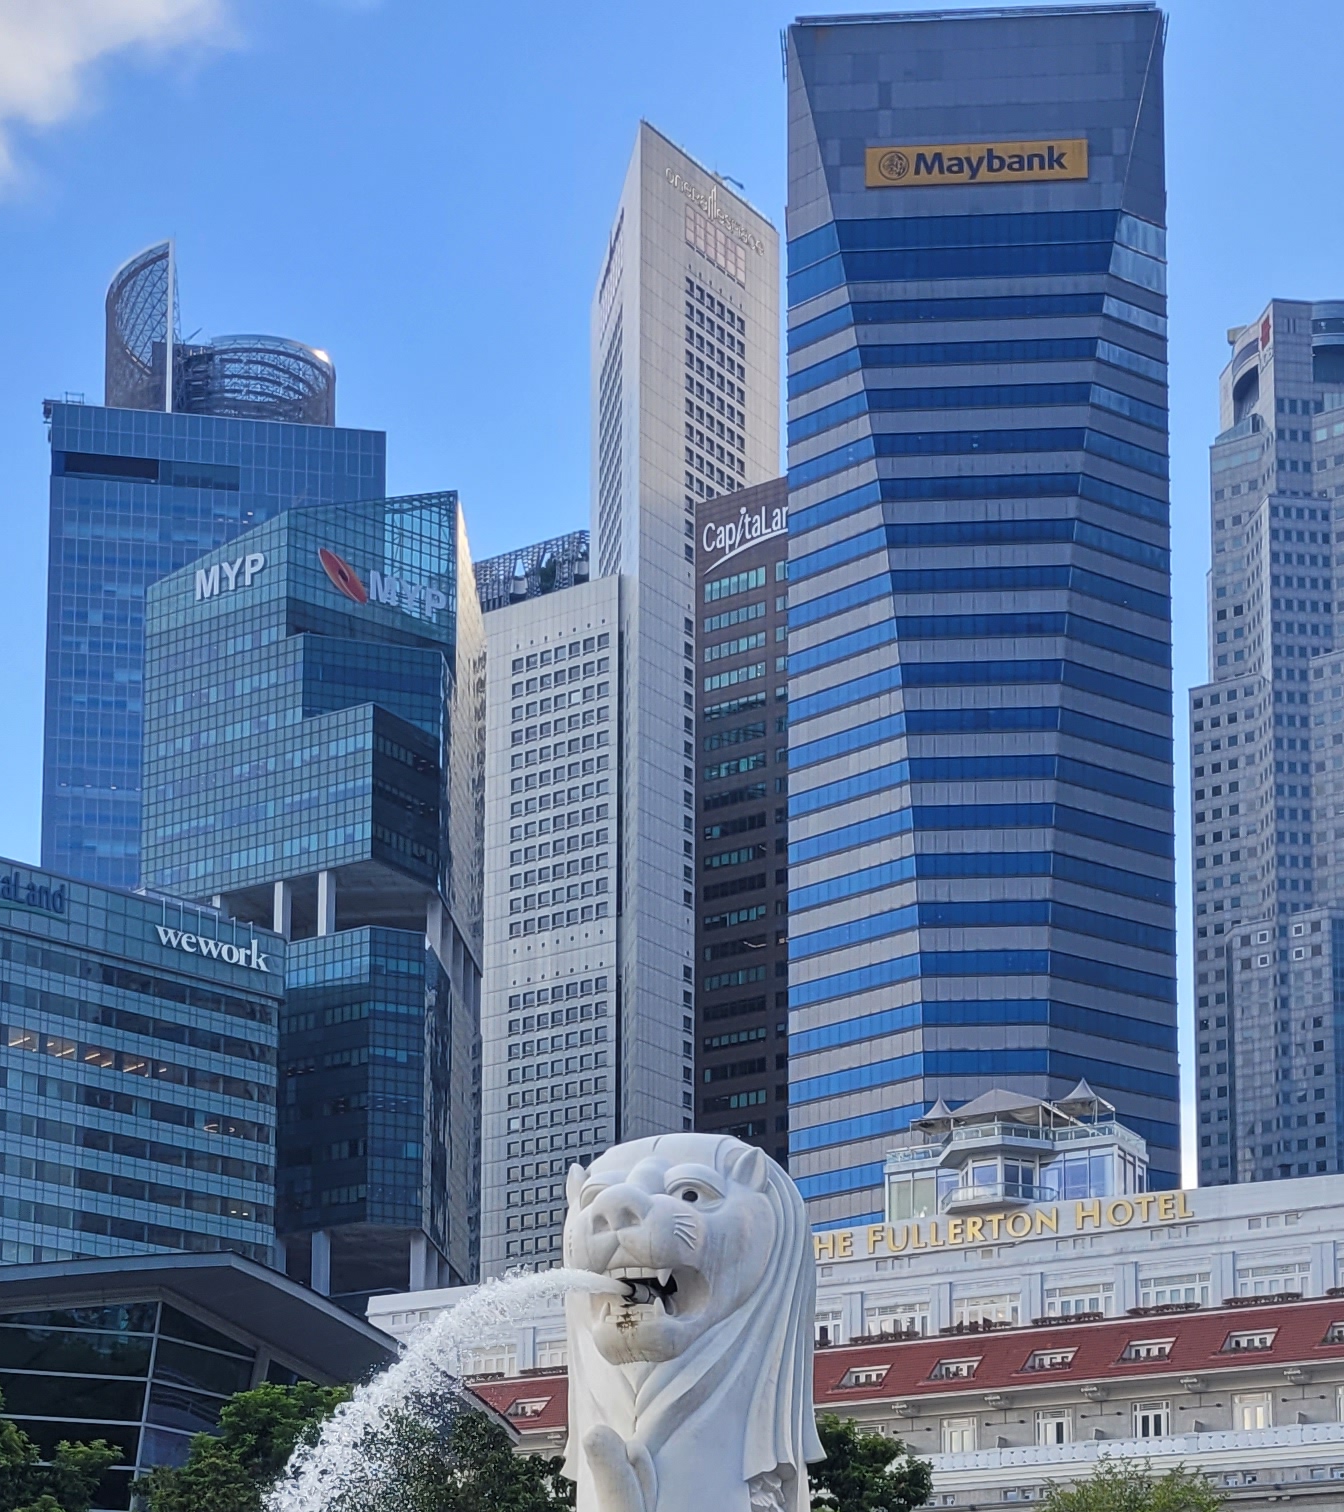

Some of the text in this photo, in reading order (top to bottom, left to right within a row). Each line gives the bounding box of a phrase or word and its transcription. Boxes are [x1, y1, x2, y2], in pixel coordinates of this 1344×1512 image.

[913, 145, 1068, 181] Maybank
[195, 552, 266, 601] MYP
[369, 569, 448, 618] MYP
[155, 924, 271, 973] wework
[814, 1191, 1195, 1260] HE FULLERTON HOTEL
